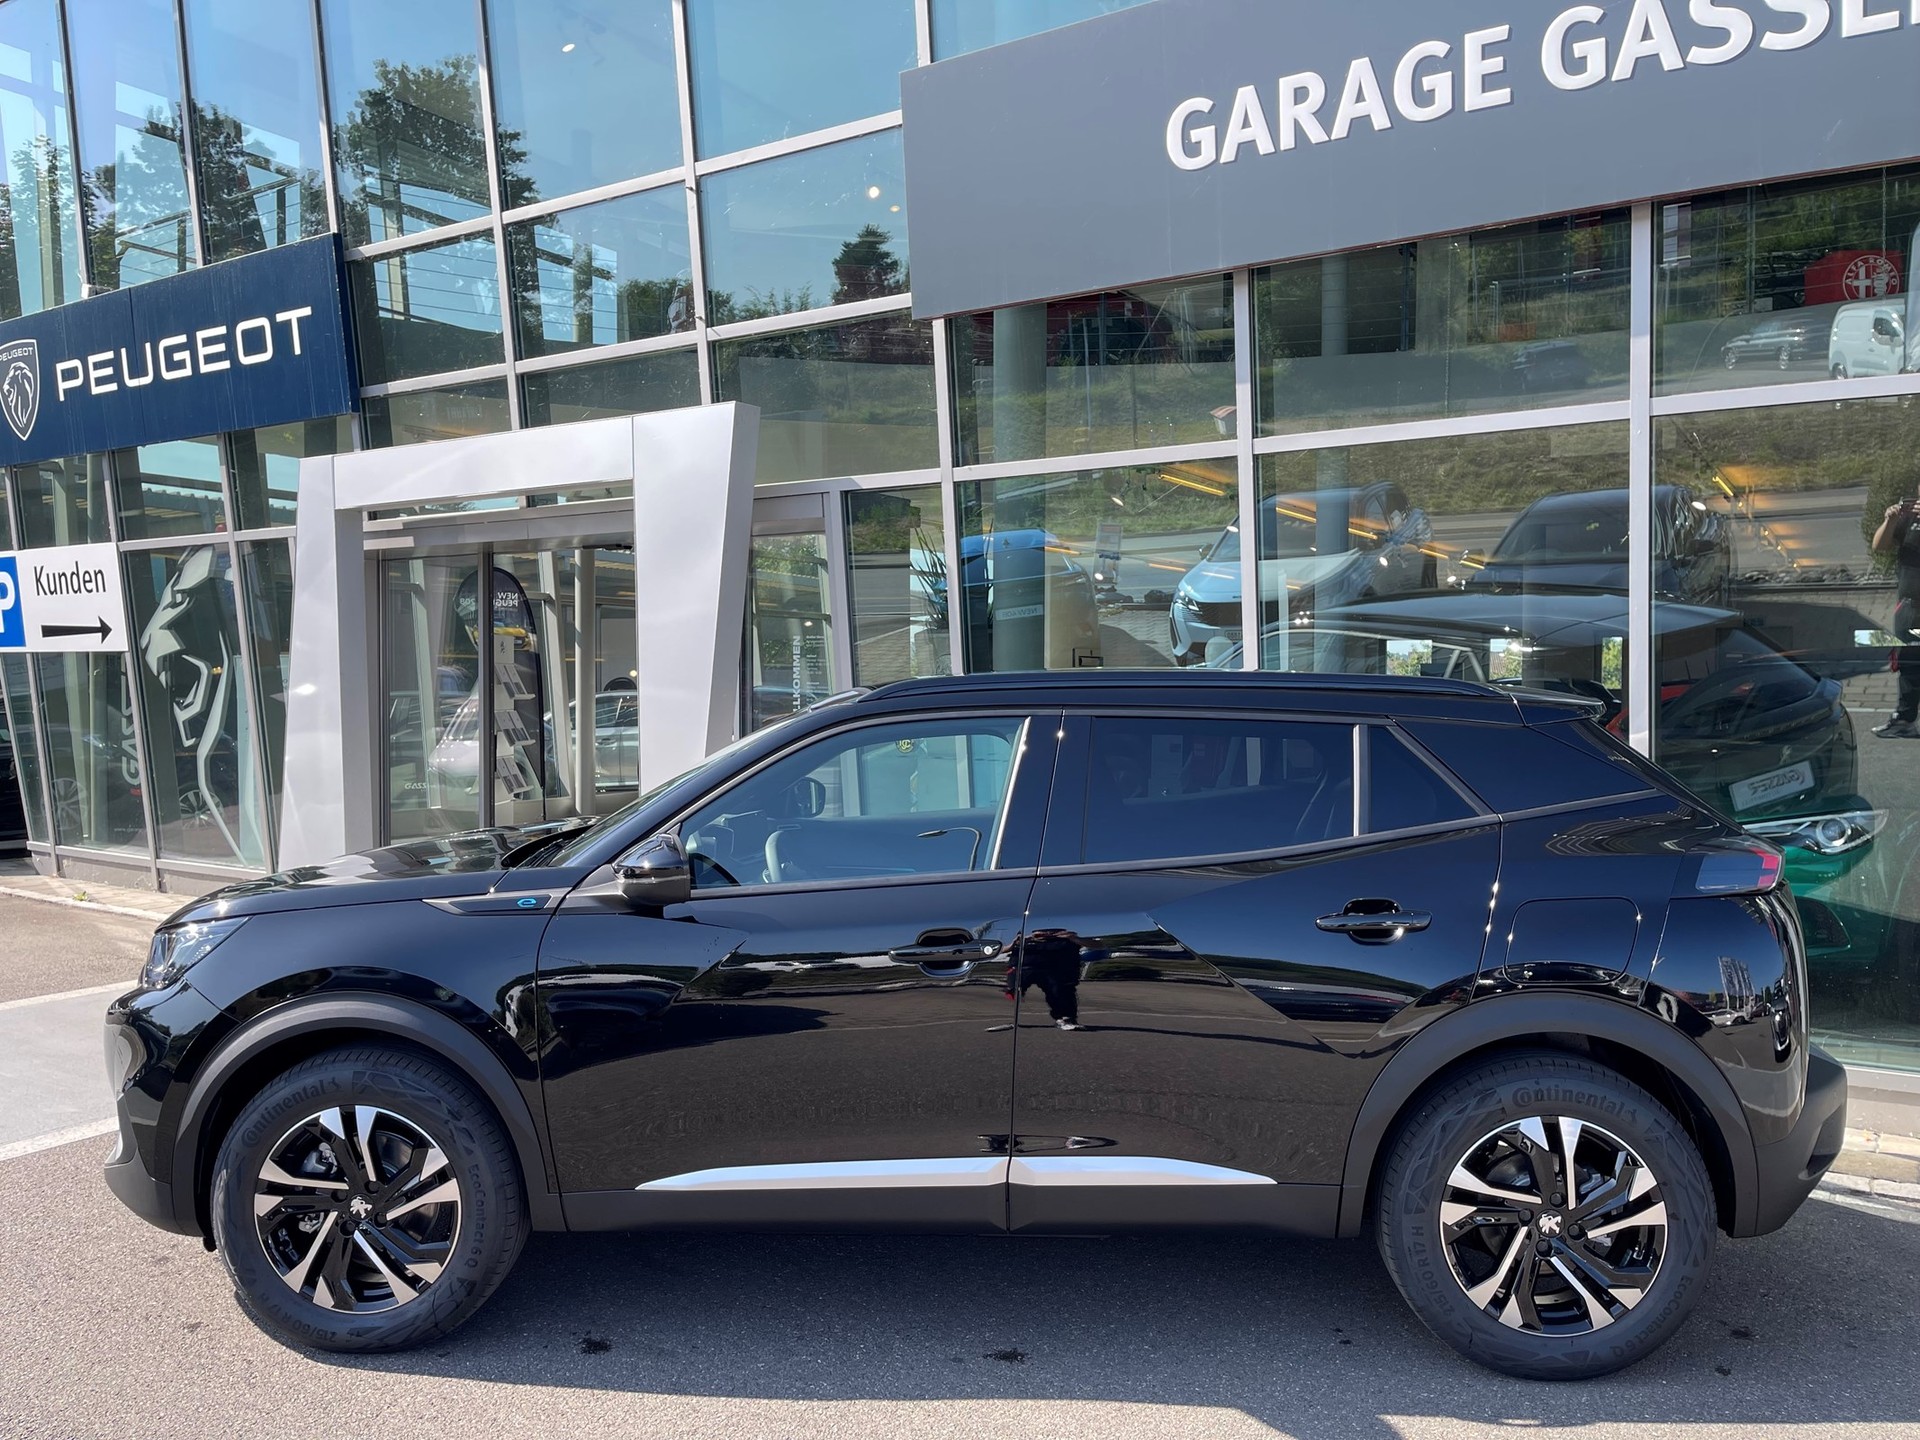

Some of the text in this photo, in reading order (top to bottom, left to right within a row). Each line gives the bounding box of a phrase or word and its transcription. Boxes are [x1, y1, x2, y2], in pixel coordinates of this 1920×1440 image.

[1166, 0, 1920, 170] GARAGE GASS
[1845, 258, 1898, 285] ALFA ROMEO
[55, 306, 312, 402] PEUGEOT
[34, 560, 106, 598] Kunden
[241, 1078, 327, 1148] Continental
[1512, 1083, 1625, 1118] Continental
[467, 1162, 488, 1244] EcoContact
[1634, 1274, 1694, 1344] EcoContact
